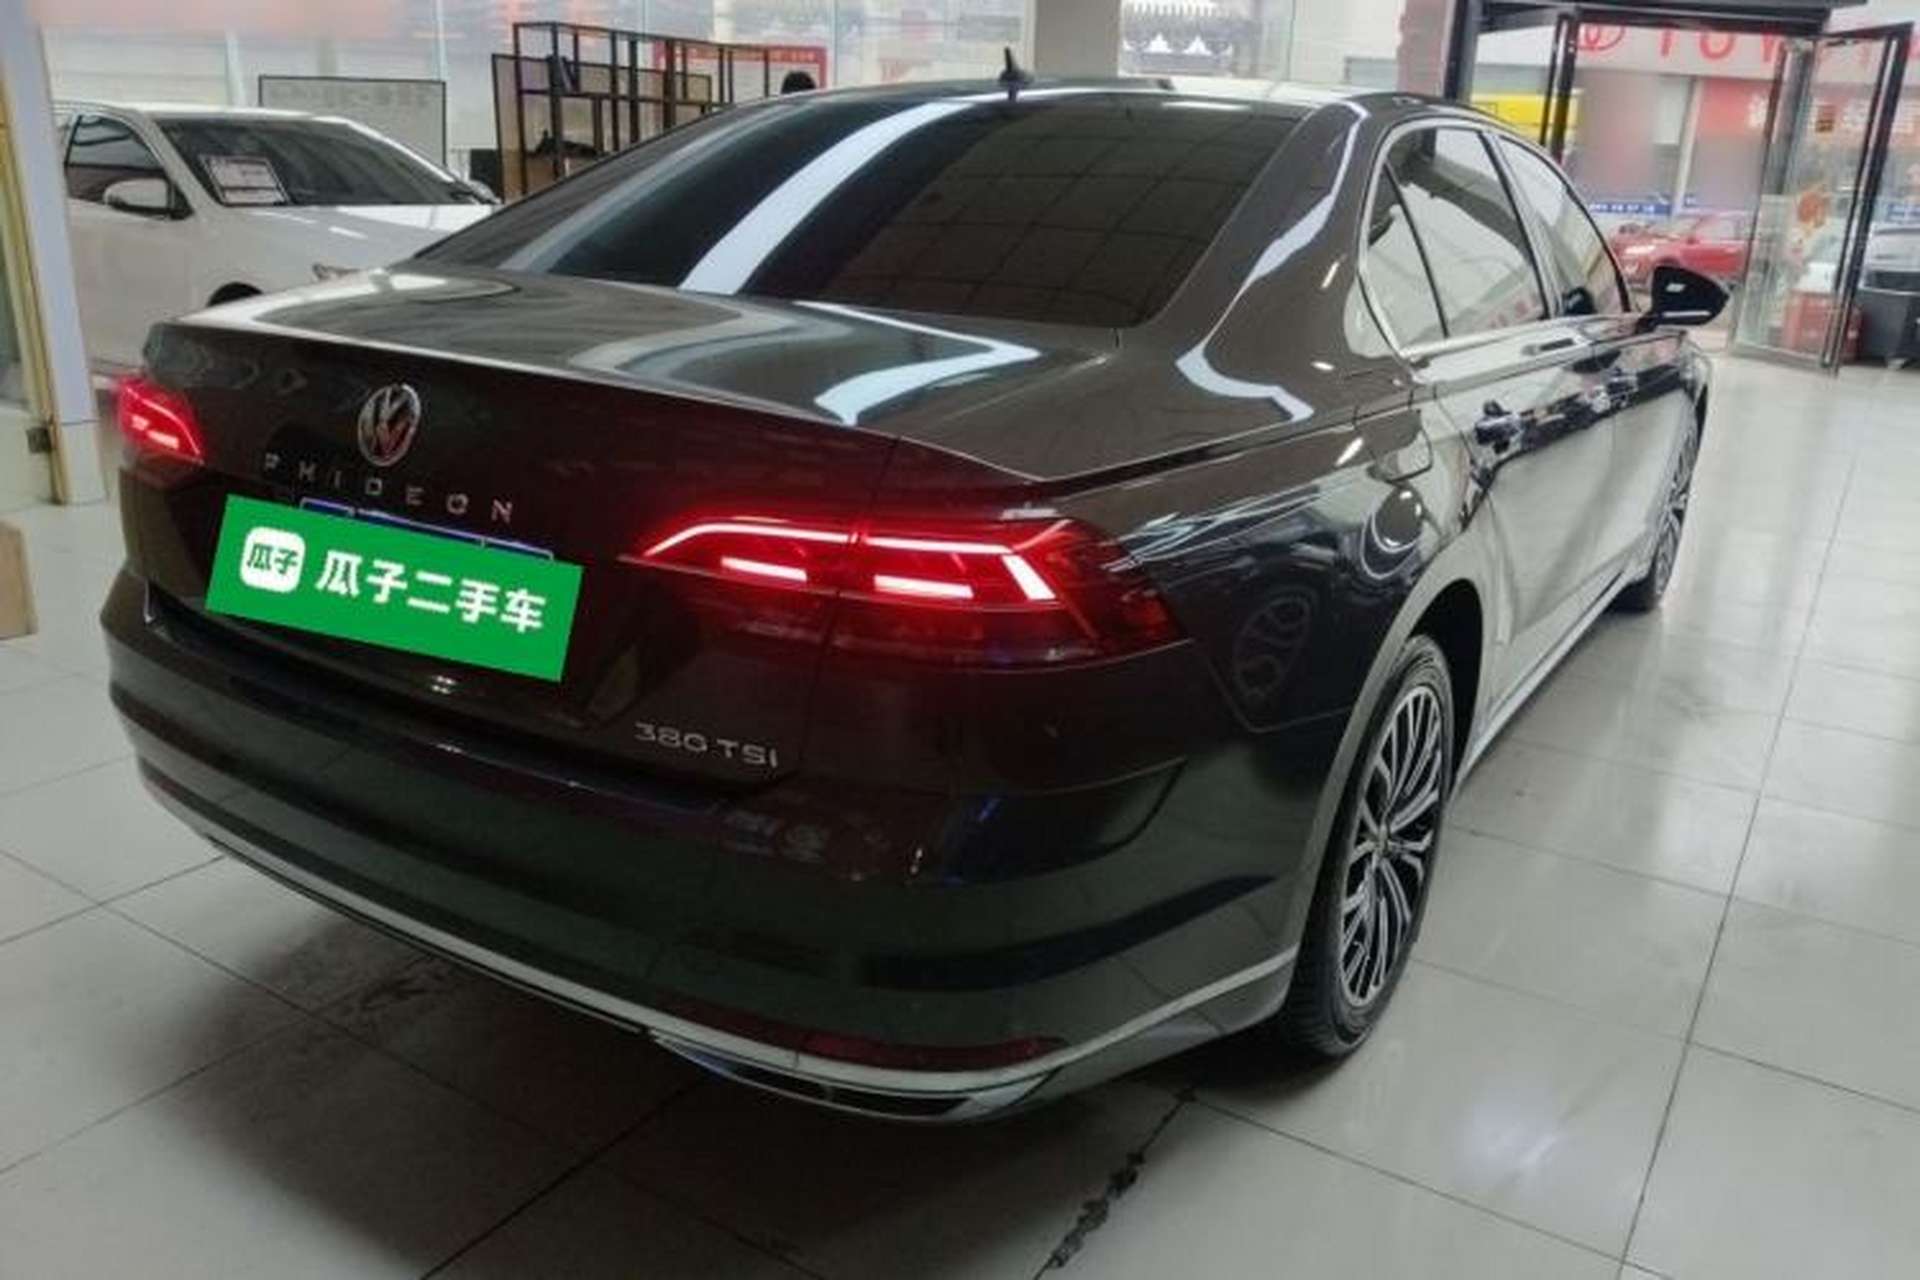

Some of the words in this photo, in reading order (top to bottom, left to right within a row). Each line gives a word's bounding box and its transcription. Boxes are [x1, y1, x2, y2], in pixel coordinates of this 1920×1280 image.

[265, 452, 513, 524] PHIDEON
[634, 721, 708, 752] 380
[716, 738, 777, 768] TSI
